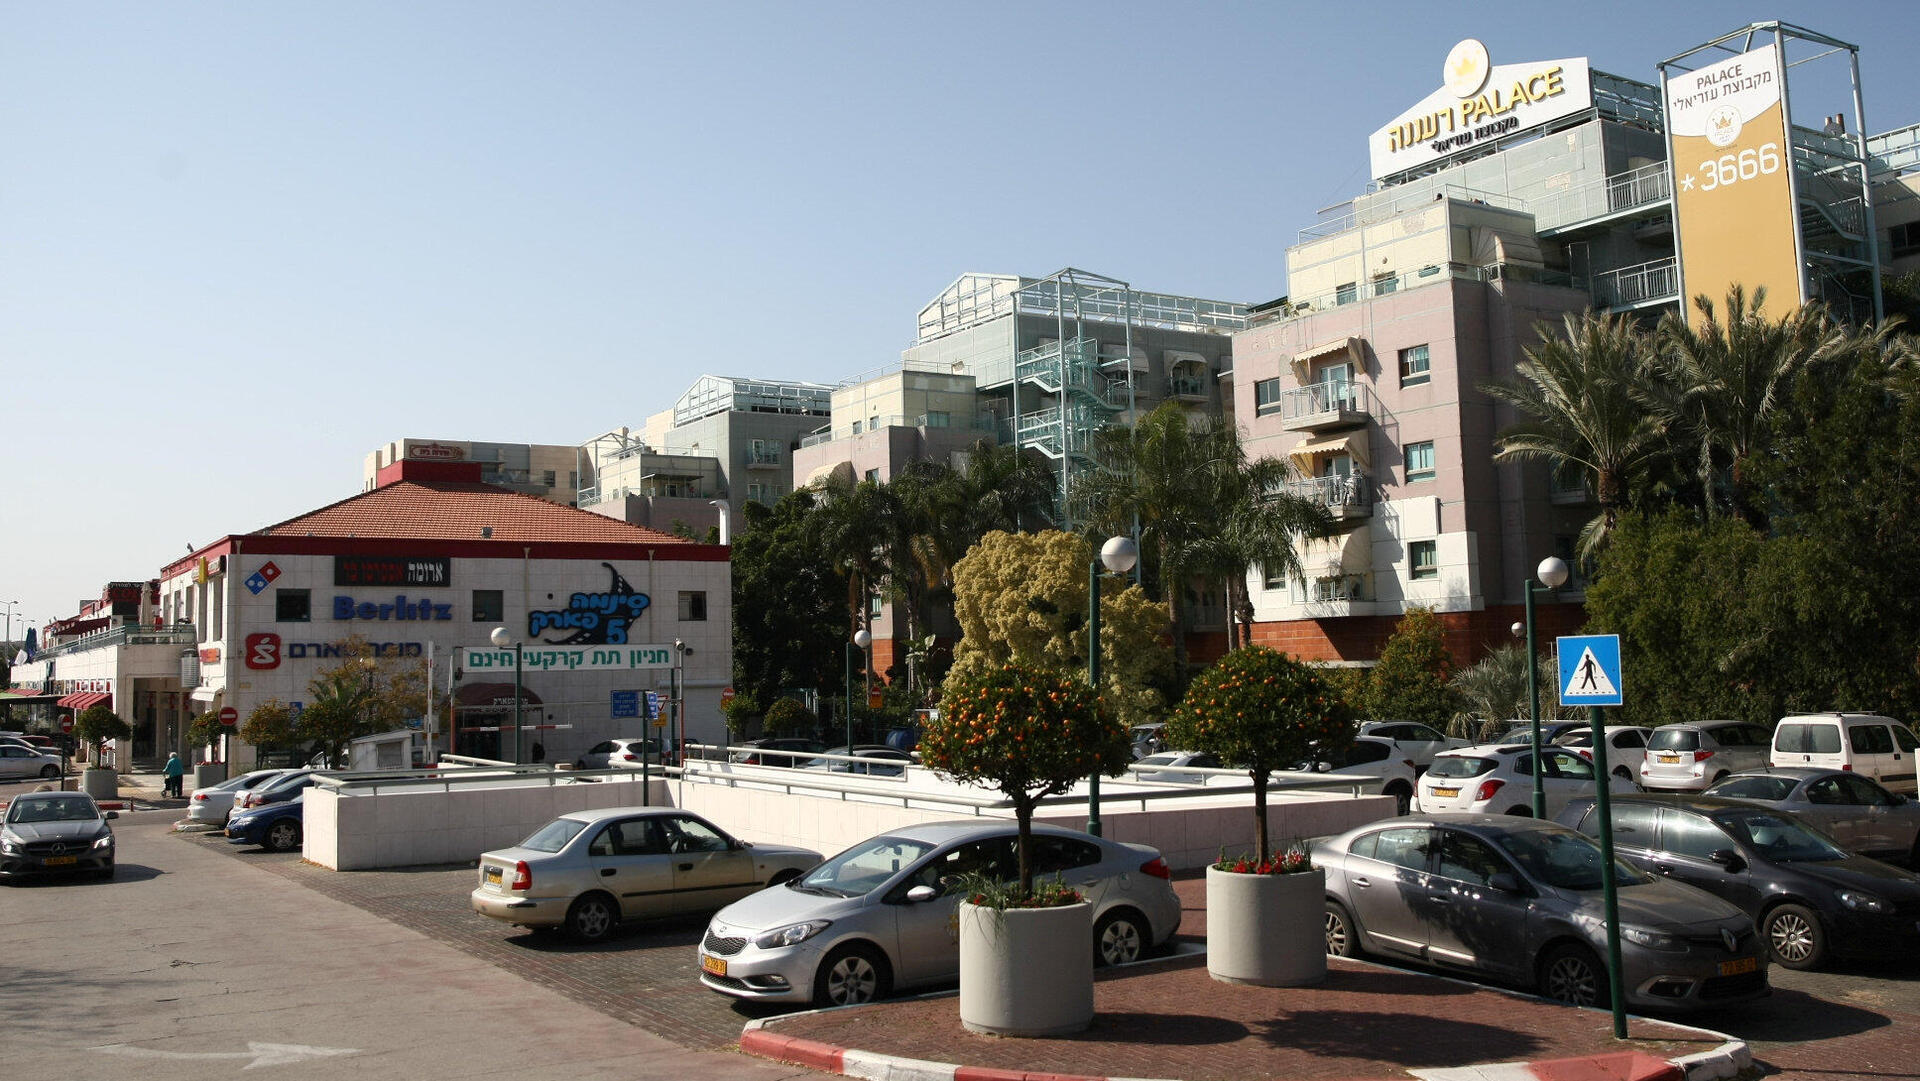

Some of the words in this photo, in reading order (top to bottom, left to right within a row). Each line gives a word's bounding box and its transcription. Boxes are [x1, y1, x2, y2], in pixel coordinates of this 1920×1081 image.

[1697, 64, 1743, 90] PALACE
[1722, 70, 1772, 97] מקבוצת
[1461, 66, 1564, 128] PALACE
[1673, 91, 1719, 112] עזריאלי
[1387, 107, 1455, 153] רעננה
[407, 562, 443, 582] ארומה
[333, 595, 453, 621] Berlitz
[571, 592, 650, 617] סינמה
[531, 610, 599, 637] פארק
[605, 618, 627, 645] 5
[289, 642, 350, 659] ארם
[469, 652, 513, 667] חינם
[523, 651, 584, 669] קרקעי
[592, 651, 621, 665] תת
[630, 650, 669, 669] חניון
